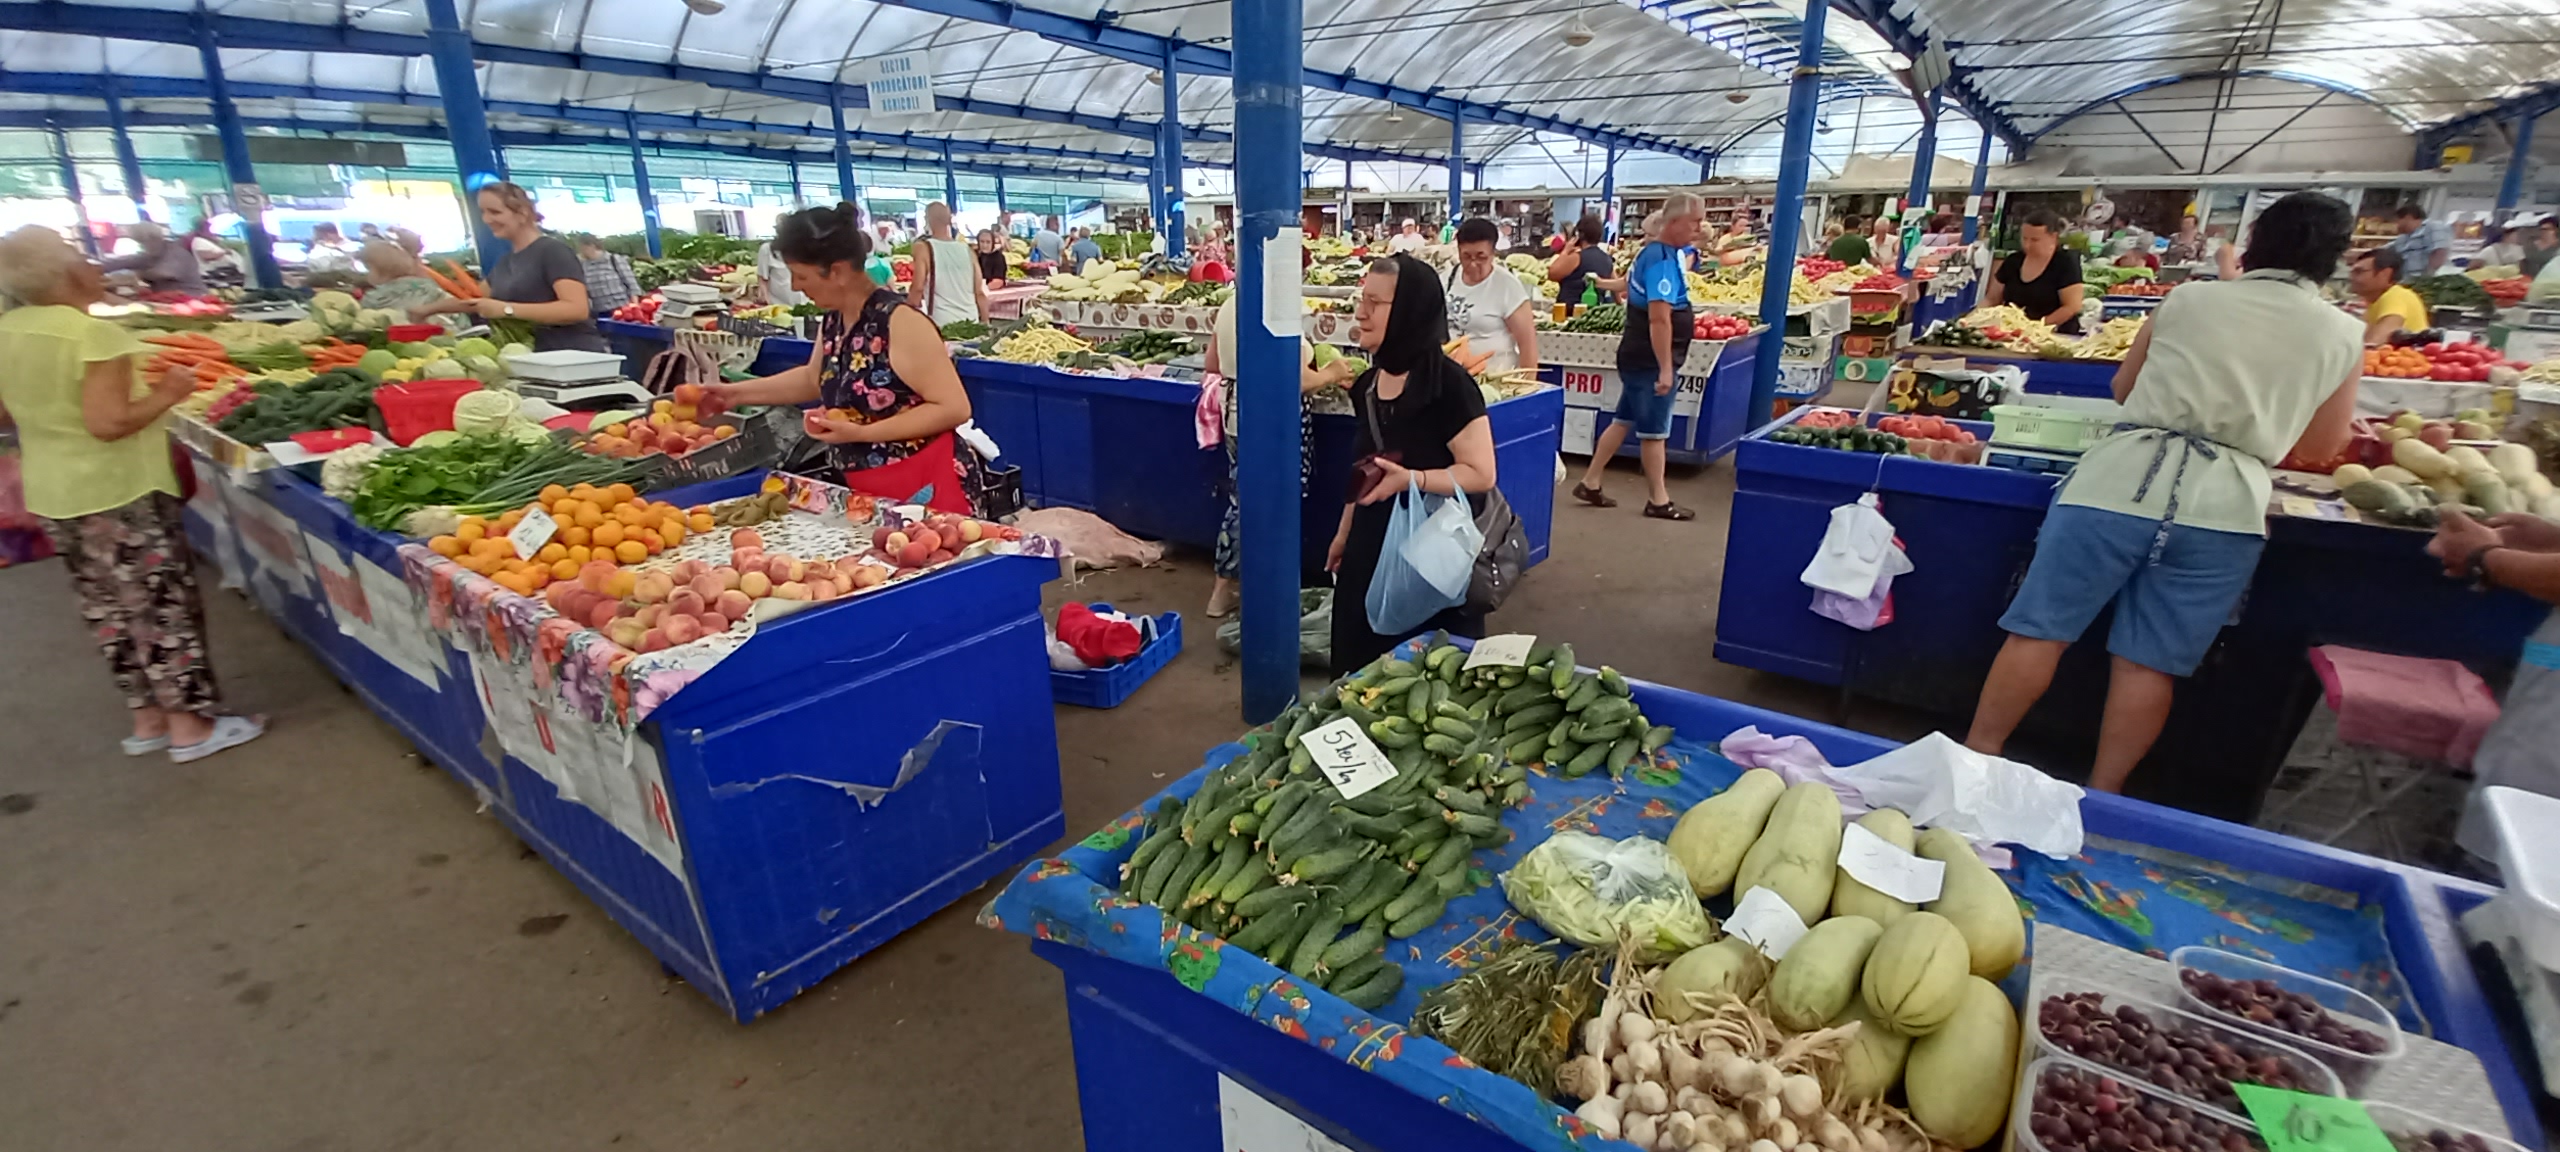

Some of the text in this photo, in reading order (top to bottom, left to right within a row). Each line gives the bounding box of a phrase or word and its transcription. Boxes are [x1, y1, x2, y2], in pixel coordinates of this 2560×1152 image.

[1565, 372, 1704, 394] PRO 249
[1323, 730, 1354, 744] 5
